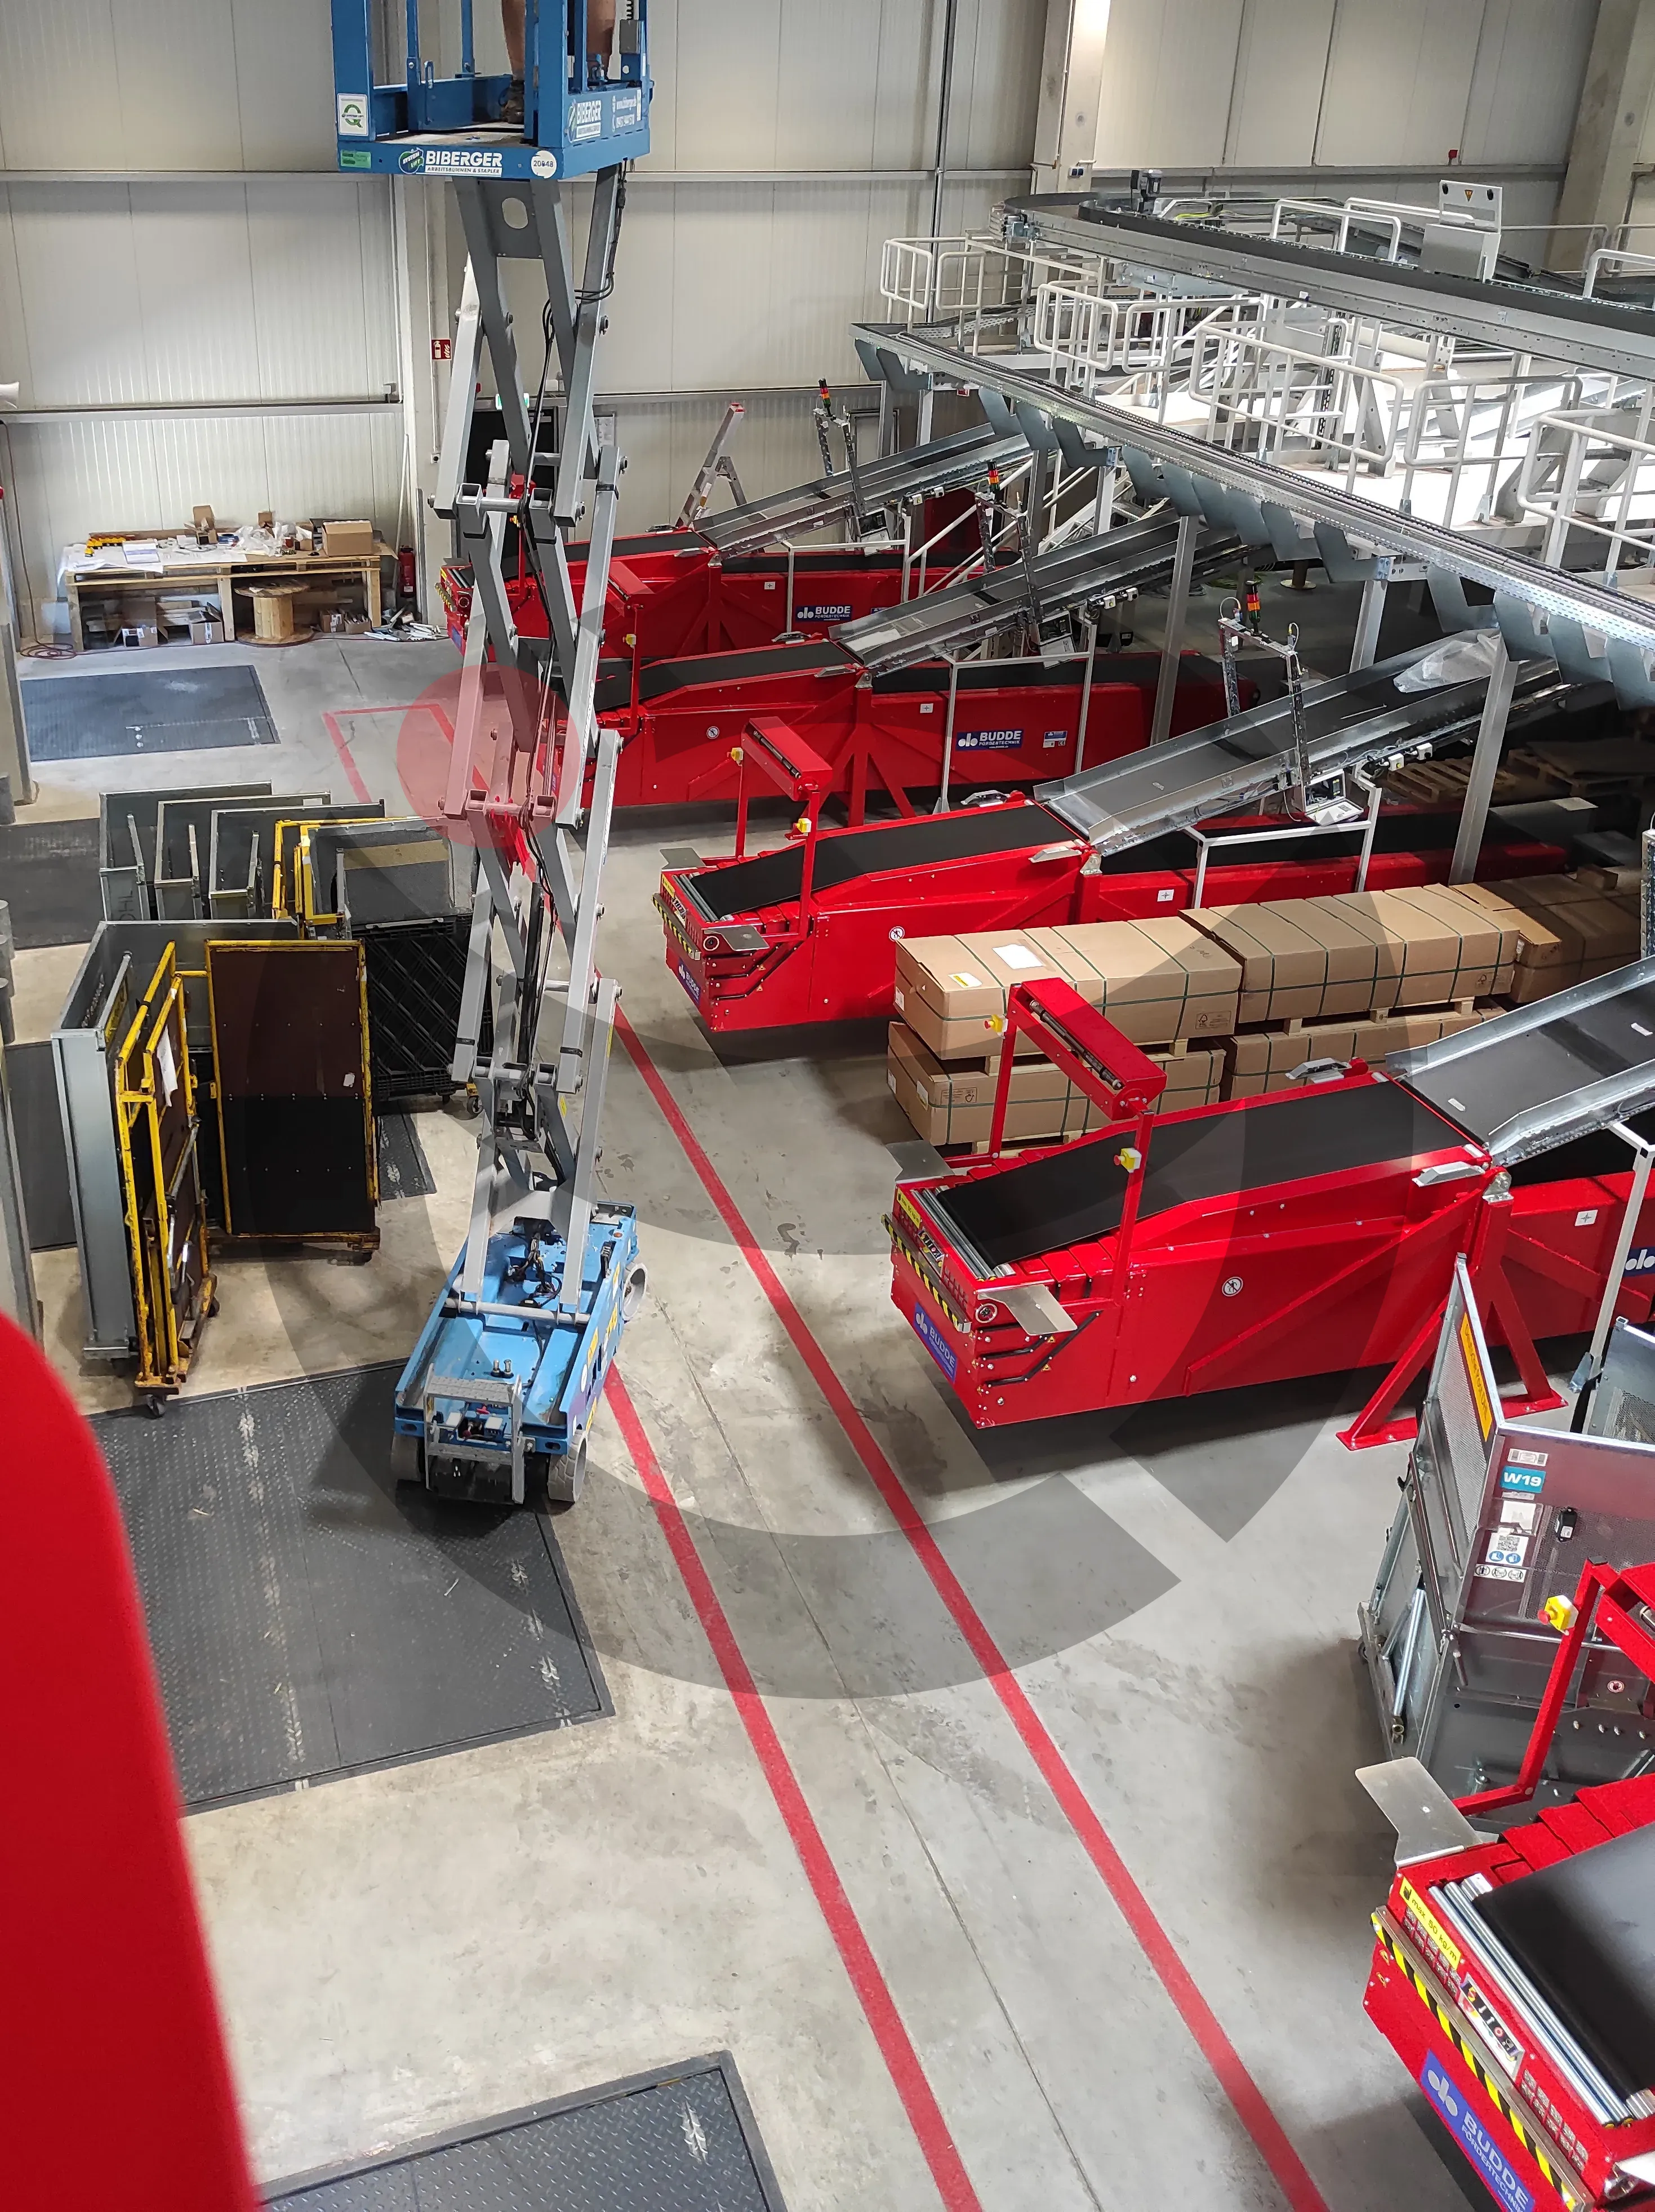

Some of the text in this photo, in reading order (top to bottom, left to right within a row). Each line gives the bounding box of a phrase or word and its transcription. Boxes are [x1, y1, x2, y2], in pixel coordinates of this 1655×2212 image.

[576, 100, 602, 125] BIBERGER
[425, 150, 502, 167] BIBERGER
[815, 606, 851, 615] BUDDE
[979, 730, 1022, 742] BUDDE
[686, 971, 700, 996] BUDDE
[929, 1326, 956, 1368] BUDDE
[1503, 1472, 1542, 1487] W19
[1429, 1919, 1438, 1934] 50
[1439, 1934, 1457, 1961] kg/m
[1463, 2111, 1529, 2211] BUDDE
